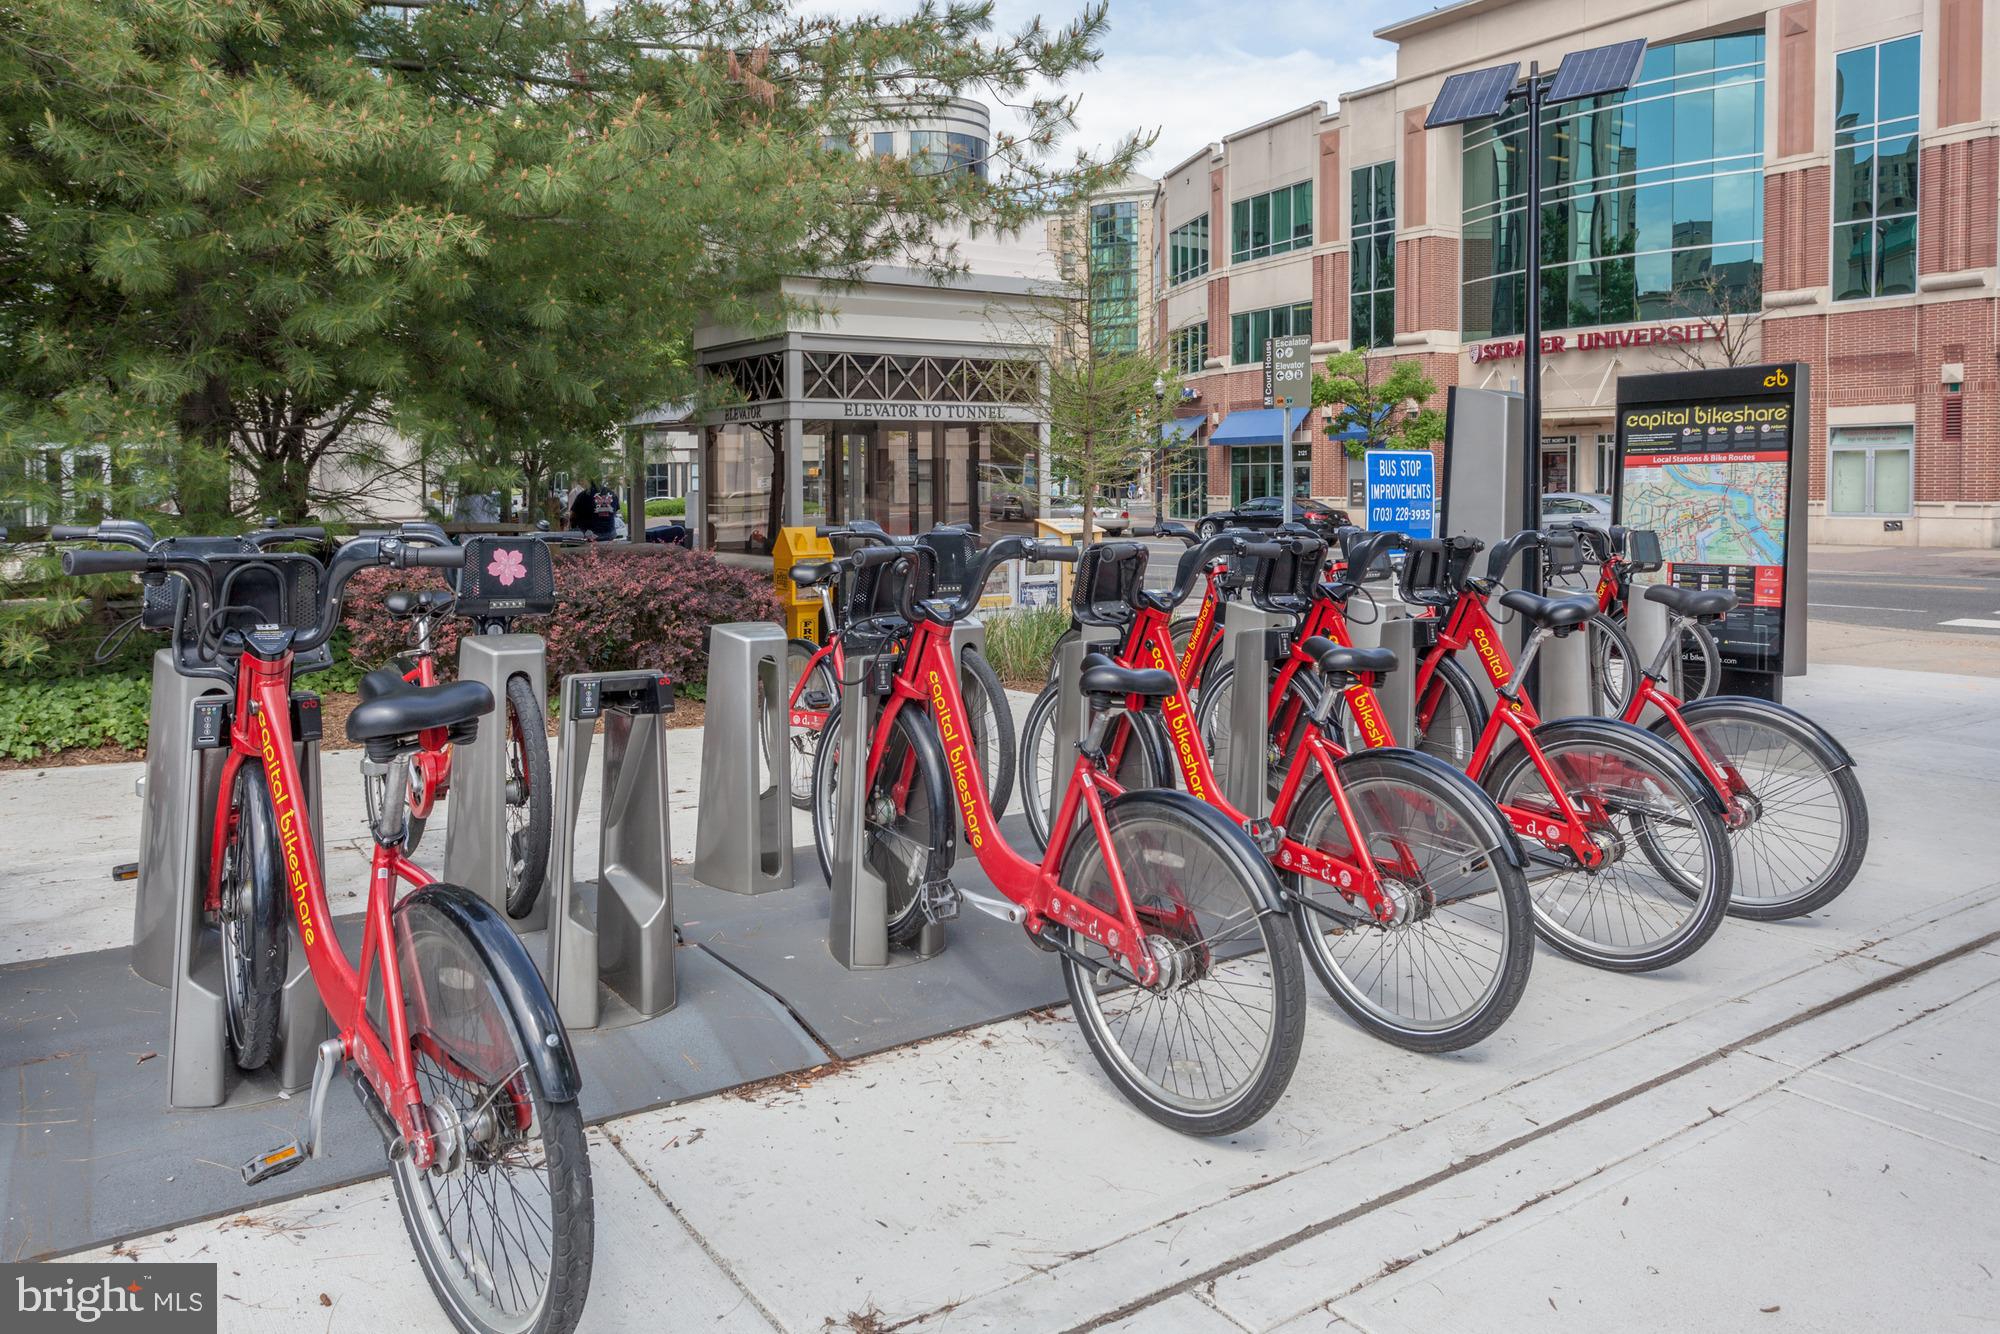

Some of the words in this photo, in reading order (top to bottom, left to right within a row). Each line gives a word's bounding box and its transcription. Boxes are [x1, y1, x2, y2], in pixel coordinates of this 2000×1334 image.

[1275, 338, 1309, 347] Escalator
[1481, 336, 1566, 361] STRAER
[1577, 321, 1726, 351] UNIVERSITY
[1275, 361, 1305, 370] Elevator
[844, 403, 918, 417] ELEVATOR
[923, 404, 942, 418] TO
[946, 405, 1006, 419] TUNNEL
[1626, 408, 1690, 430] capital
[1694, 405, 1788, 424] bikeshare
[1379, 459, 1397, 477] BUS
[1400, 460, 1422, 477] STOP
[1672, 455, 1702, 463] Stations
[1710, 454, 1727, 462] Bike
[1728, 453, 1756, 461] Routes
[1371, 483, 1431, 499] IMPROVEMENTS
[1373, 507, 1392, 522] (703)
[1395, 507, 1431, 521] 228-3935
[1180, 651, 1192, 680] pital
[1188, 599, 1212, 650] bikeshare
[1474, 628, 1509, 679] capital
[1354, 691, 1386, 748] bikesh
[929, 671, 959, 742] capital
[950, 744, 983, 849] bikeshare
[1172, 713, 1206, 801] bikeshare
[258, 711, 289, 805] capital
[280, 808, 315, 946] bikeshare
